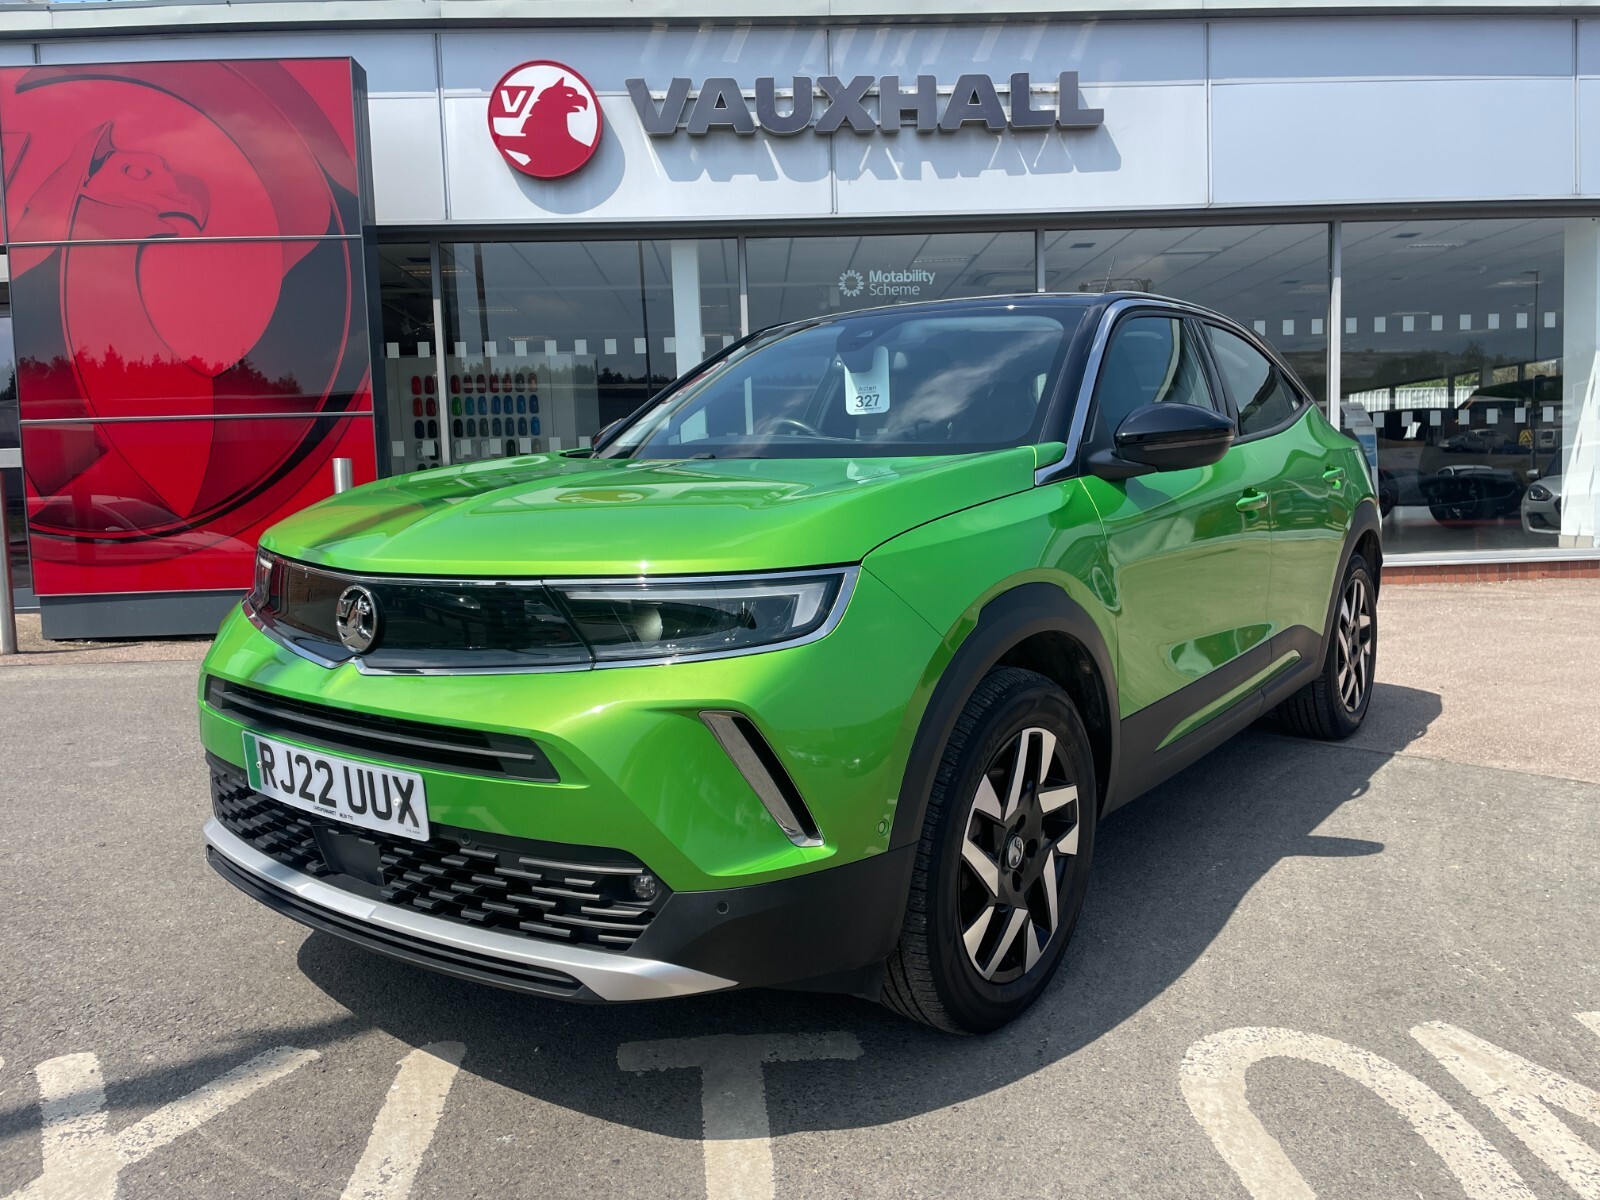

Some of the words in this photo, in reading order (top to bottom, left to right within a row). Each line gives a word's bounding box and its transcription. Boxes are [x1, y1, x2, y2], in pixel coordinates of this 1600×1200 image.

[625, 71, 1105, 136] VAUXHALL
[869, 269, 936, 285] Motability
[869, 283, 921, 296] Scheme
[855, 394, 880, 408] 327
[258, 741, 338, 809] RJ22
[343, 765, 420, 828] UUX
